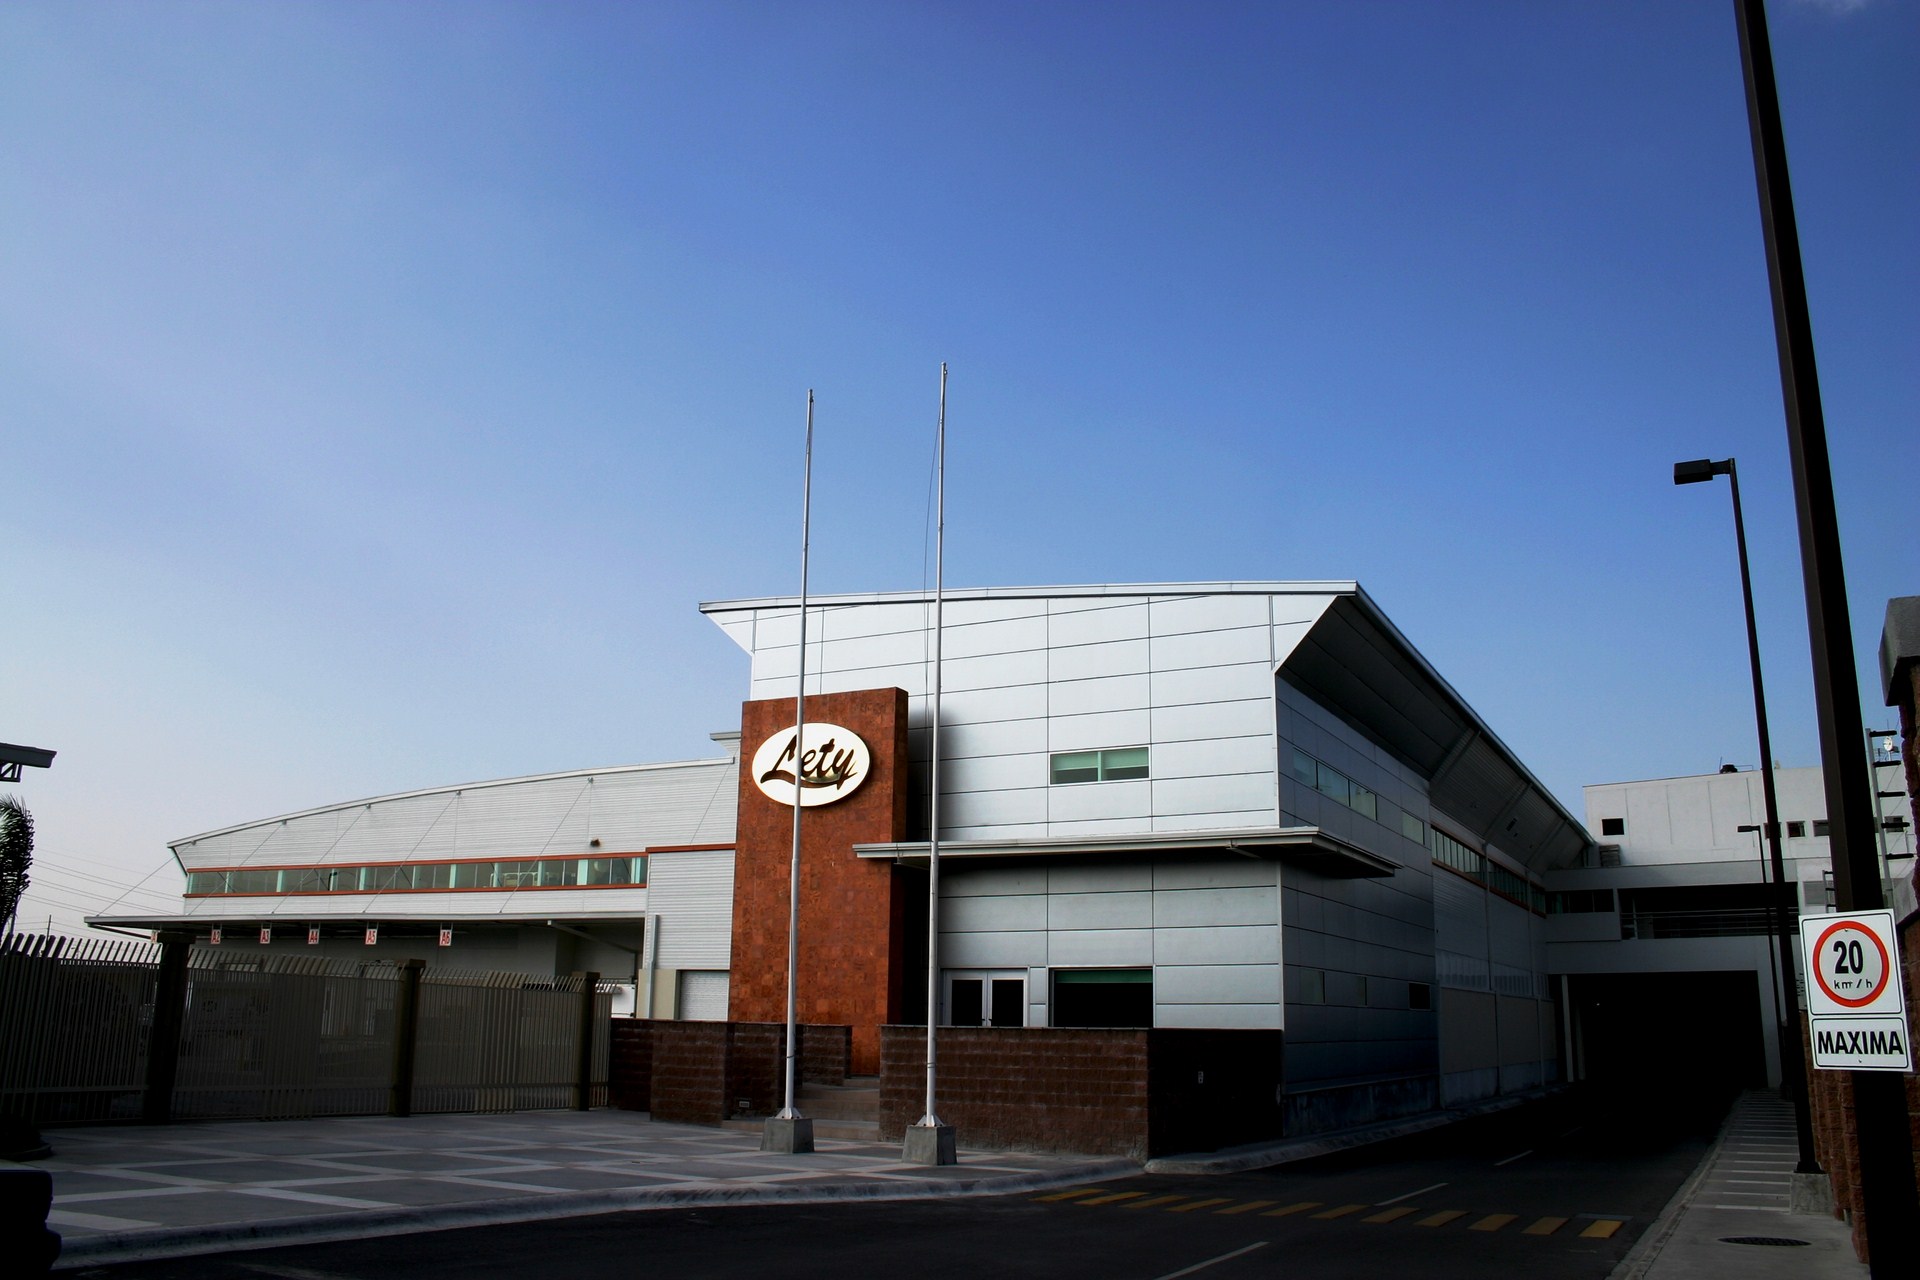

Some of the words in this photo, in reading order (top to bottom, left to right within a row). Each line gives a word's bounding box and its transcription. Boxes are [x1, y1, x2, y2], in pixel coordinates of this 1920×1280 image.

[761, 735, 858, 790] Lety
[309, 930, 318, 942] A4
[366, 930, 376, 943] A5
[1833, 940, 1863, 974] 20
[1818, 1031, 1904, 1055] MAXIMA
